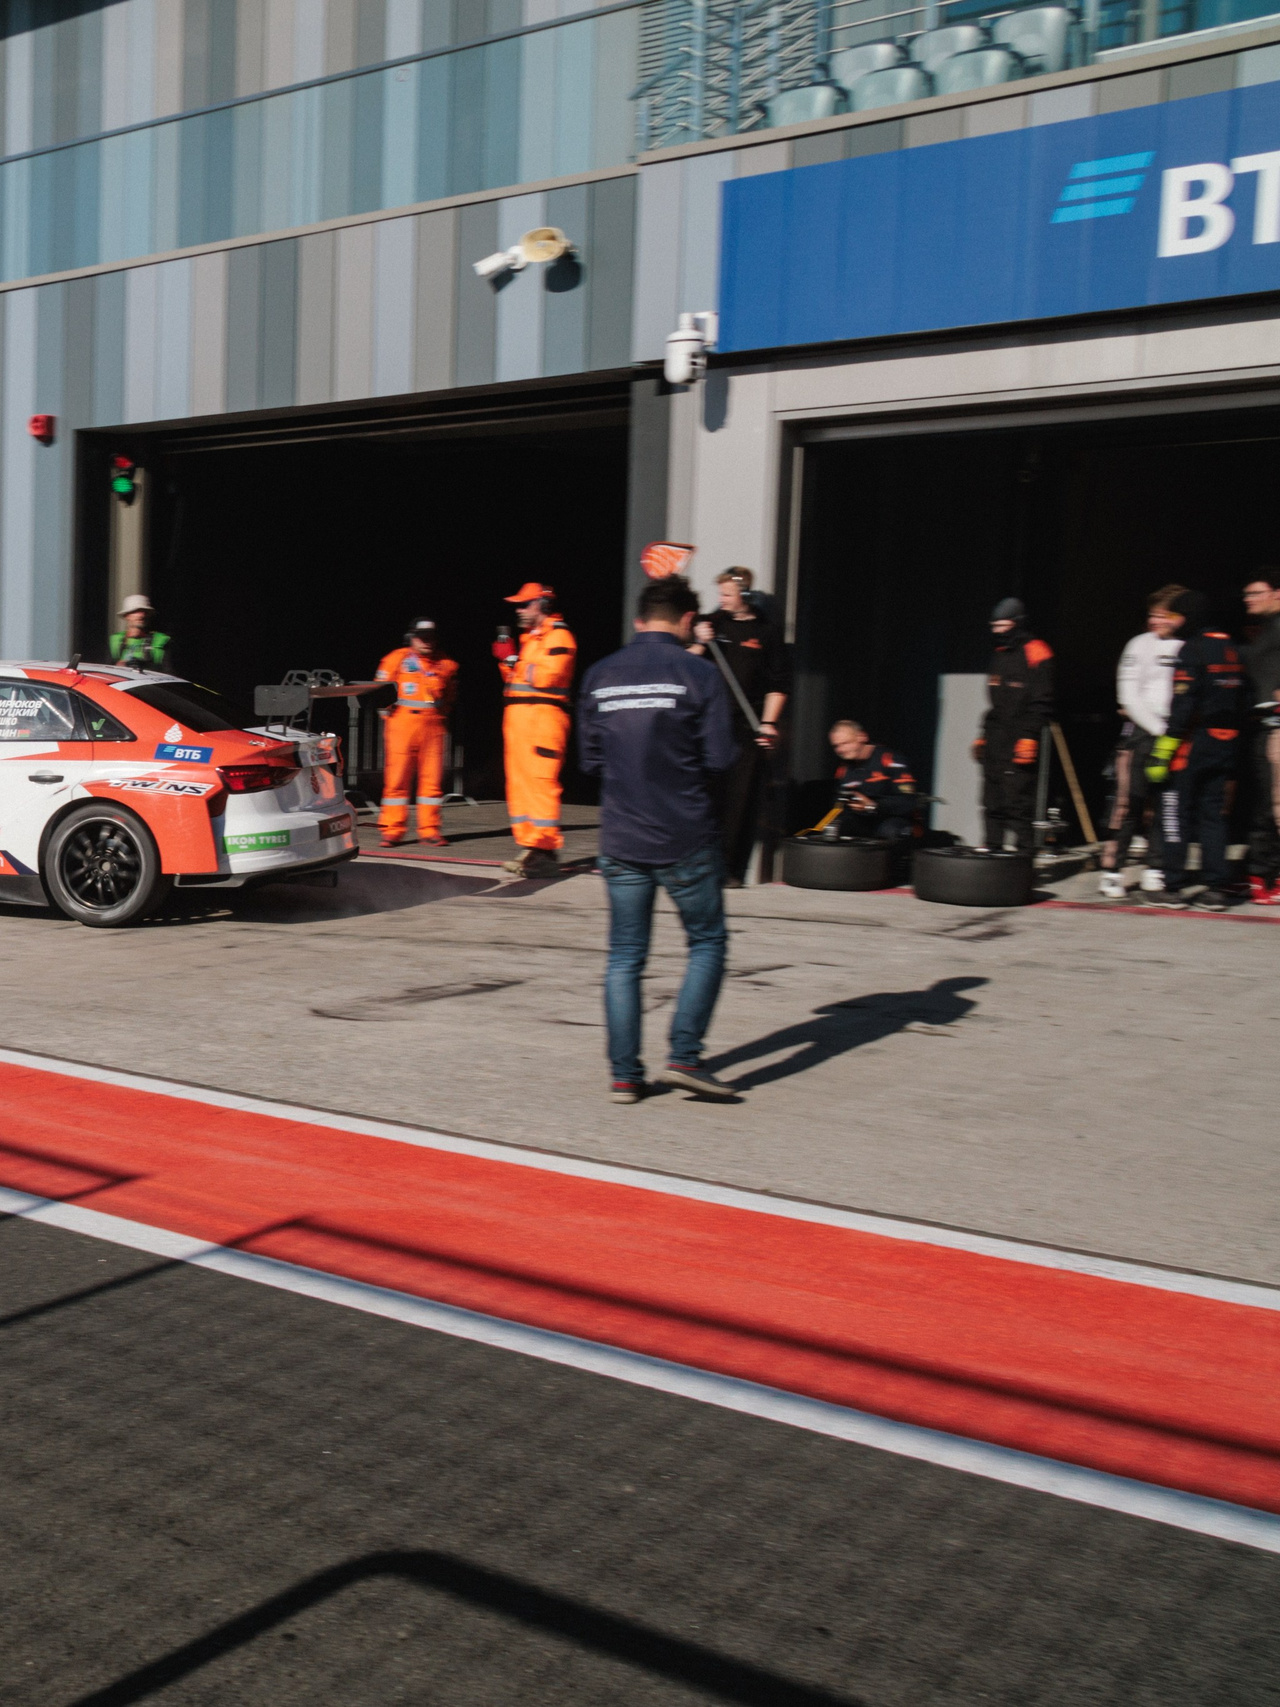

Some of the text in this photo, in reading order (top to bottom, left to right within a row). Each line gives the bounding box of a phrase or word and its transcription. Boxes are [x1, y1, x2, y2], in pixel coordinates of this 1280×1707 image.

[174, 748, 202, 760] ВТБ
[227, 834, 288, 846] IKON TYRES
